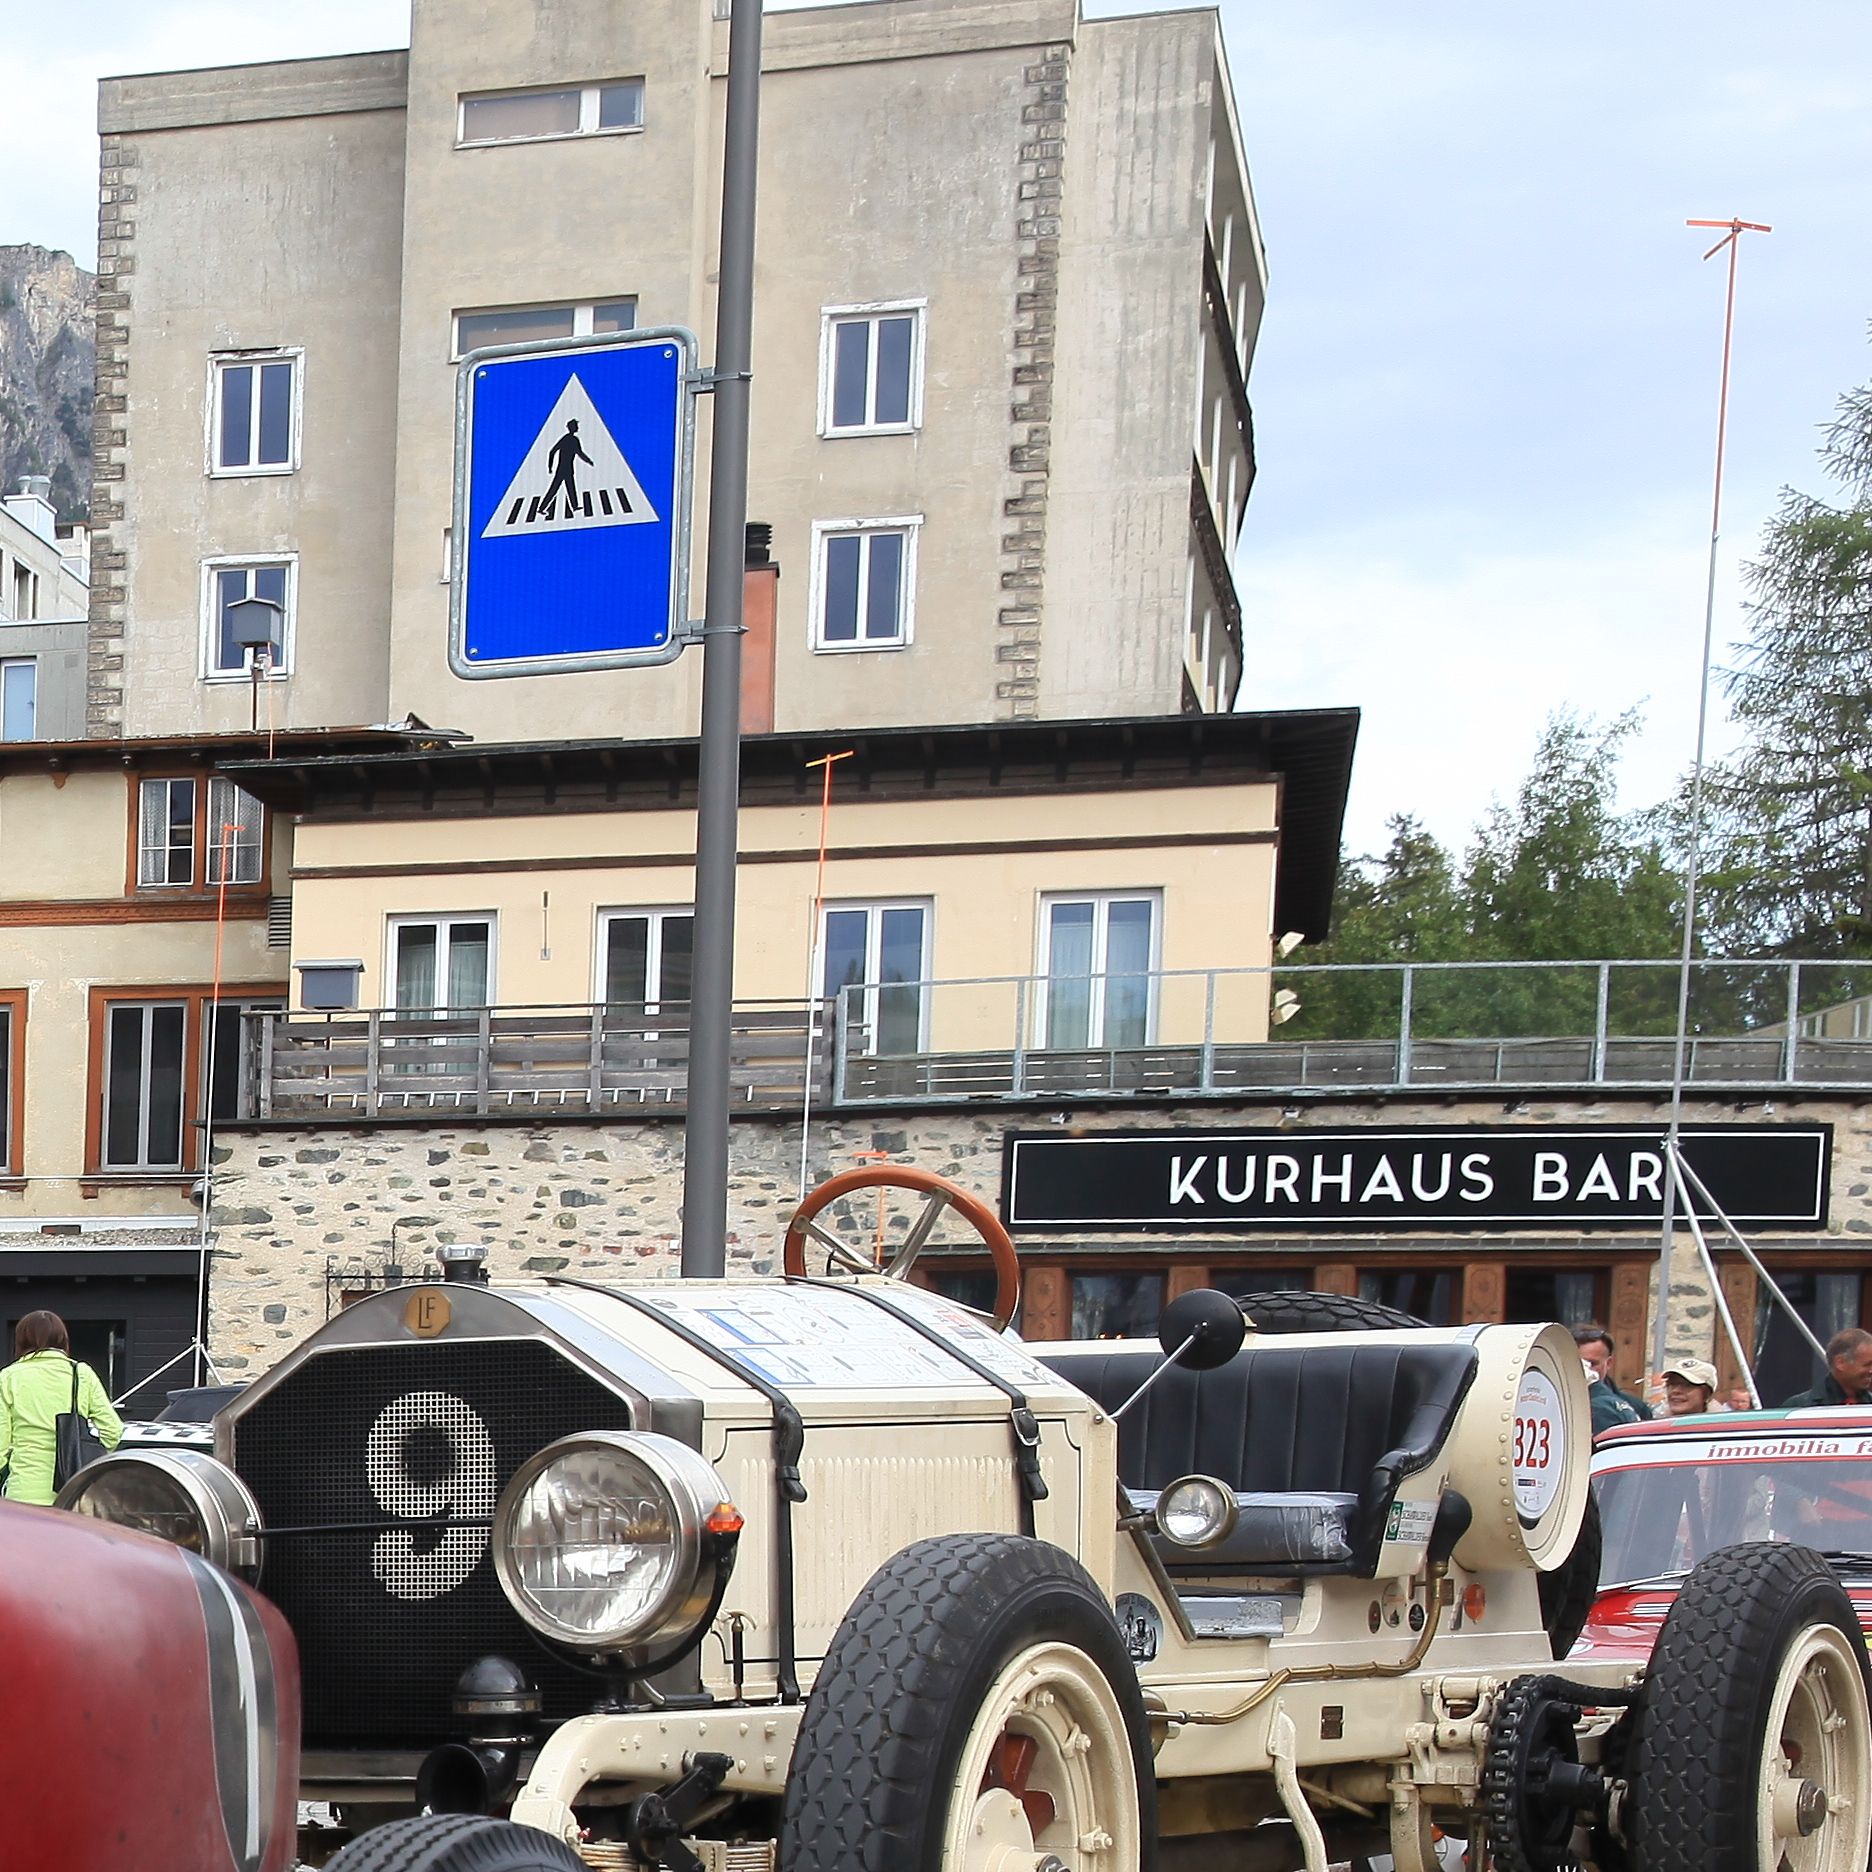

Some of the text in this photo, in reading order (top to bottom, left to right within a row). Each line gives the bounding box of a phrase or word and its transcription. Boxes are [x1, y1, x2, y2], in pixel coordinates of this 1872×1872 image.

[1169, 1150, 1664, 1204] KURHAUS BAR
[1513, 1417, 1551, 1469] 323
[1707, 1439, 1841, 1459] immobilia
[364, 1390, 498, 1602] 9
